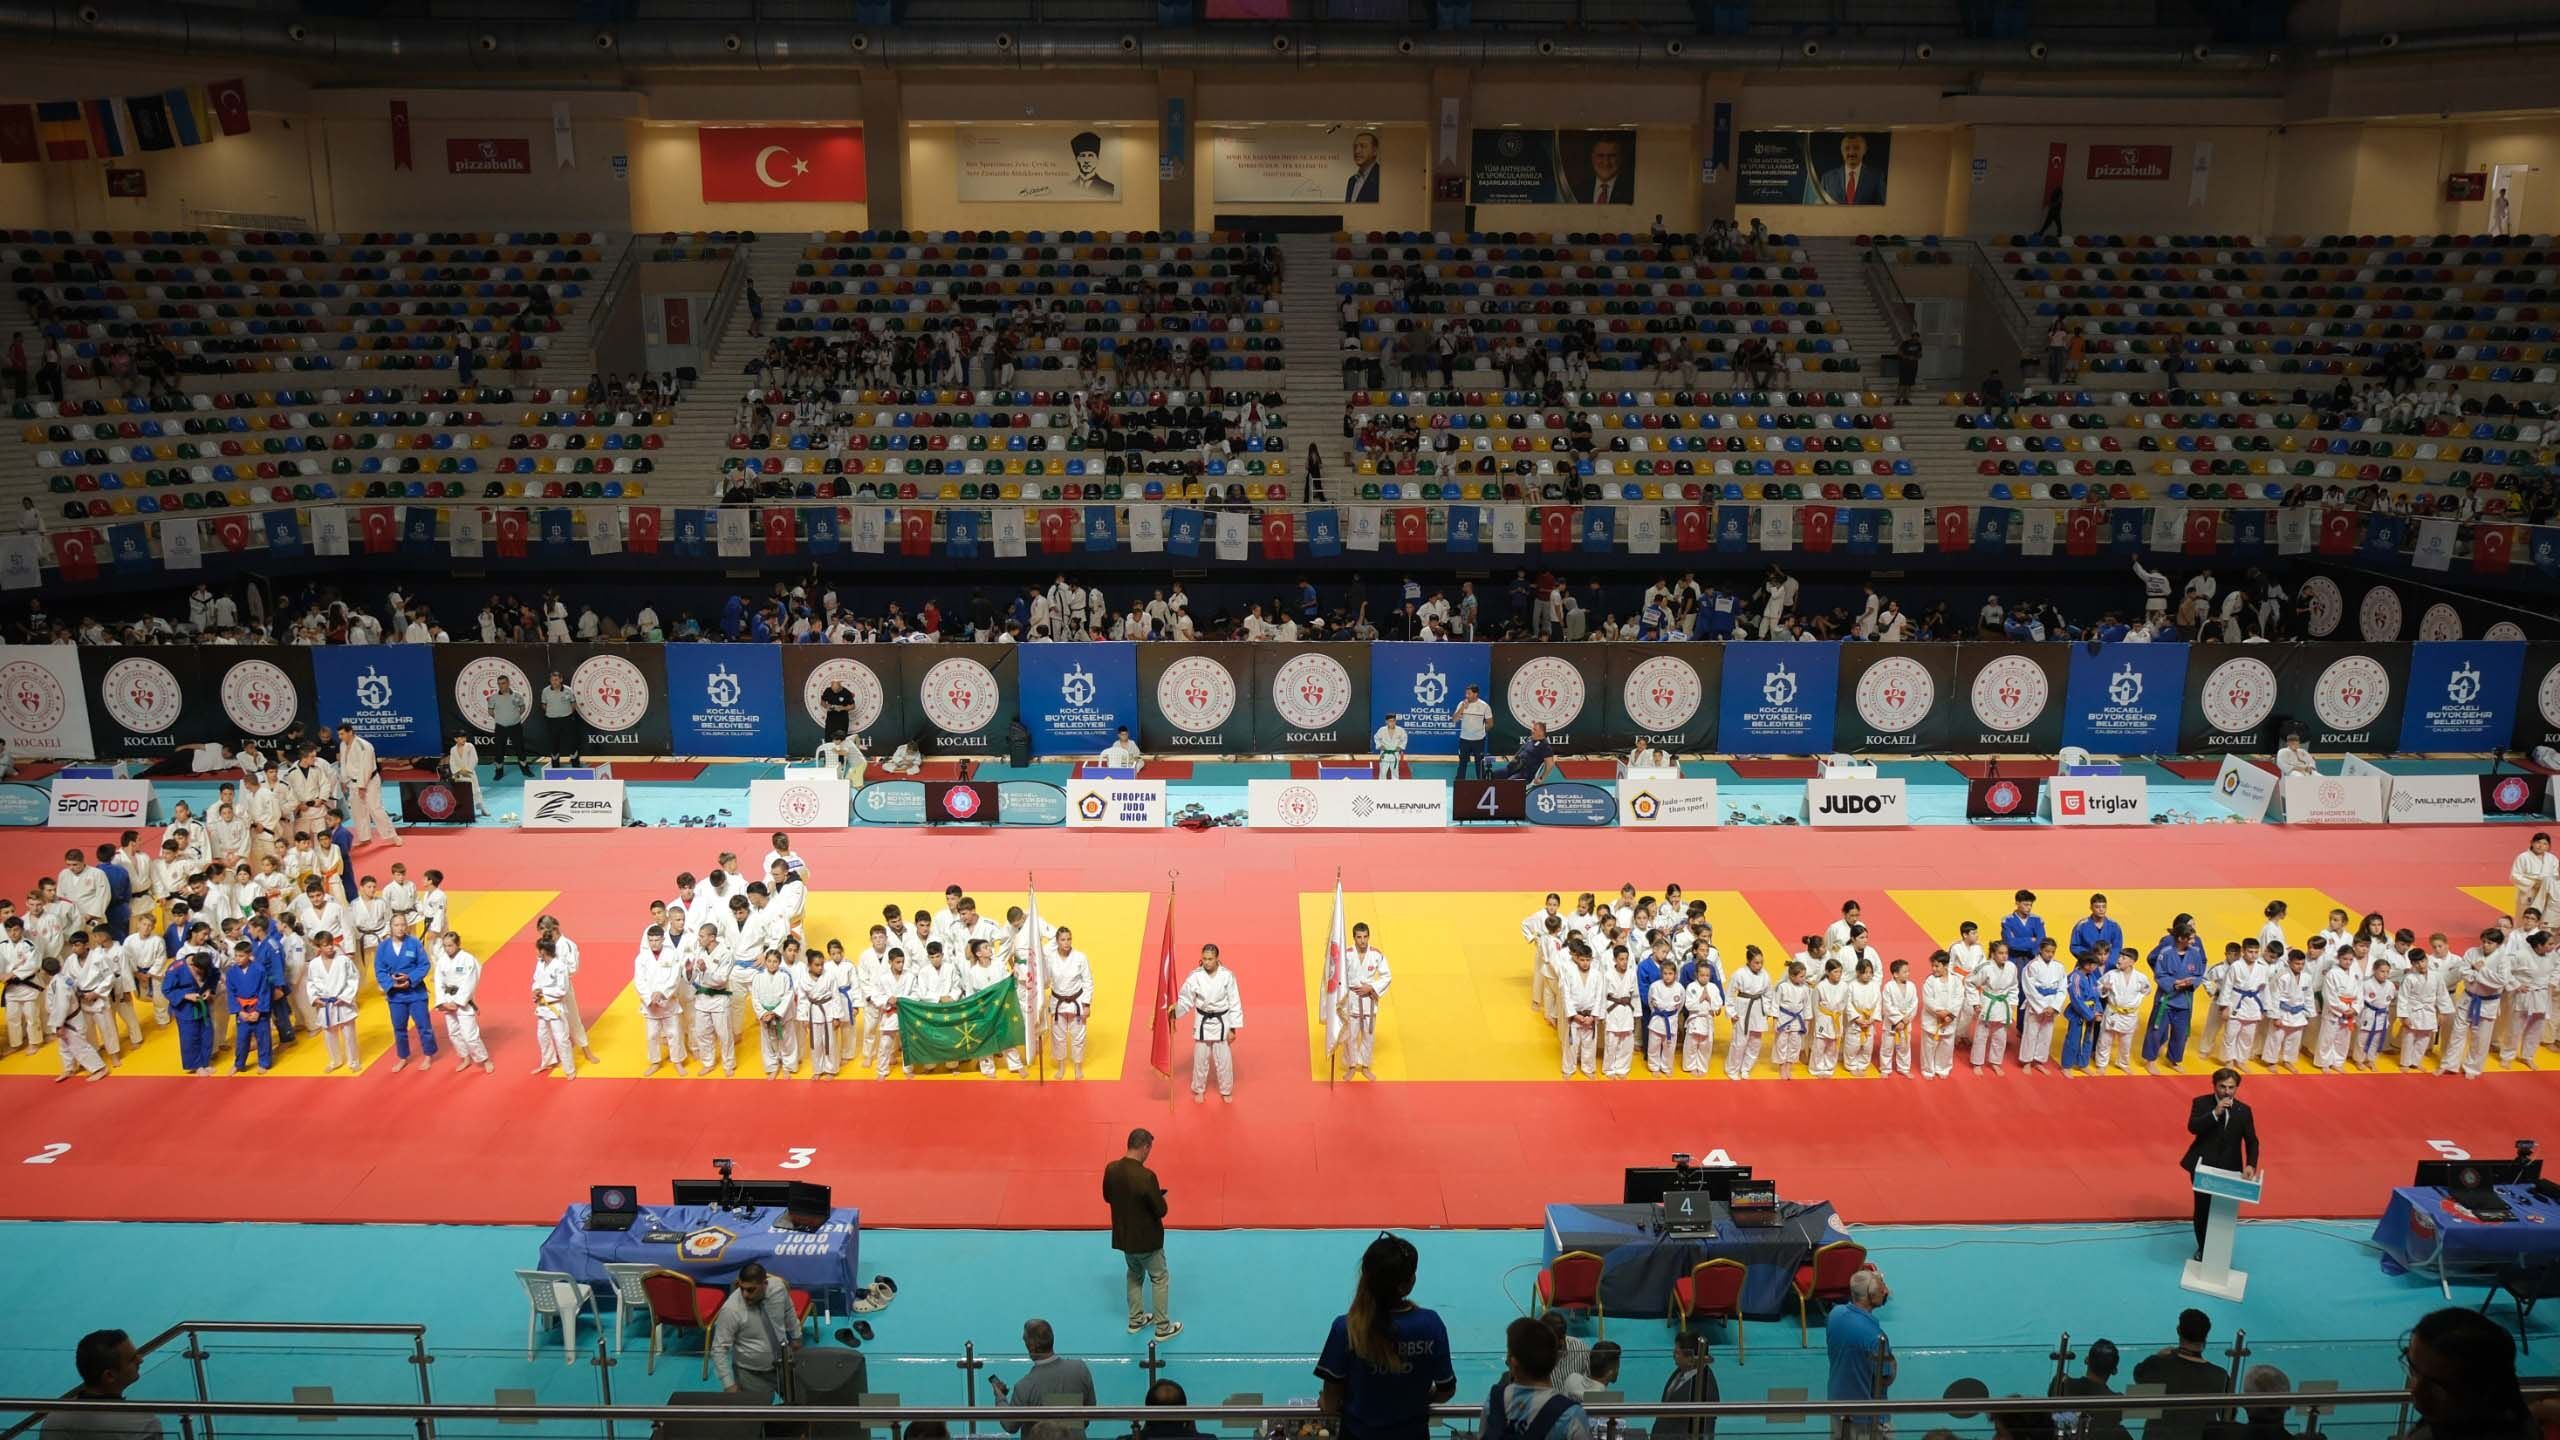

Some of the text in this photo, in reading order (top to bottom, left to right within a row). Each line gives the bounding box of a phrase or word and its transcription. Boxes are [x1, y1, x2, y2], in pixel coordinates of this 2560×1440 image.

[456, 158, 525, 173] pizzabulls
[2095, 162, 2163, 177] pizzabulls
[706, 707, 745, 715] KOCAELİ
[13, 737, 62, 748] KOCAELİ
[123, 735, 176, 747] KOCAELİ
[588, 733, 640, 745] KOCAELİ
[936, 735, 989, 747] KOCAELİ
[1172, 734, 1223, 745] KOCAELİ
[1286, 731, 1337, 743] KOCAELİ
[1519, 733, 1569, 745] KAELİ
[1866, 733, 1917, 745] KOCAELİ
[1980, 733, 2031, 744] KOCAELİ
[2208, 734, 2257, 745] KOCAELİ
[2320, 732, 2370, 743] KOCAELİ
[1111, 792, 1157, 802] EUROPEAN
[1477, 786, 1499, 816] 4
[570, 801, 612, 809] ZEBRA
[1122, 803, 1145, 812] JUDO
[2088, 794, 2138, 814] triglav
[1120, 812, 1147, 822] UNION
[23, 1142, 73, 1165] 2
[2426, 1140, 2471, 1160] 5
[779, 1147, 817, 1169] 3
[1680, 1197, 1693, 1216] 4
[783, 1232, 829, 1244] JUDO
[774, 1243, 829, 1256] UNION
